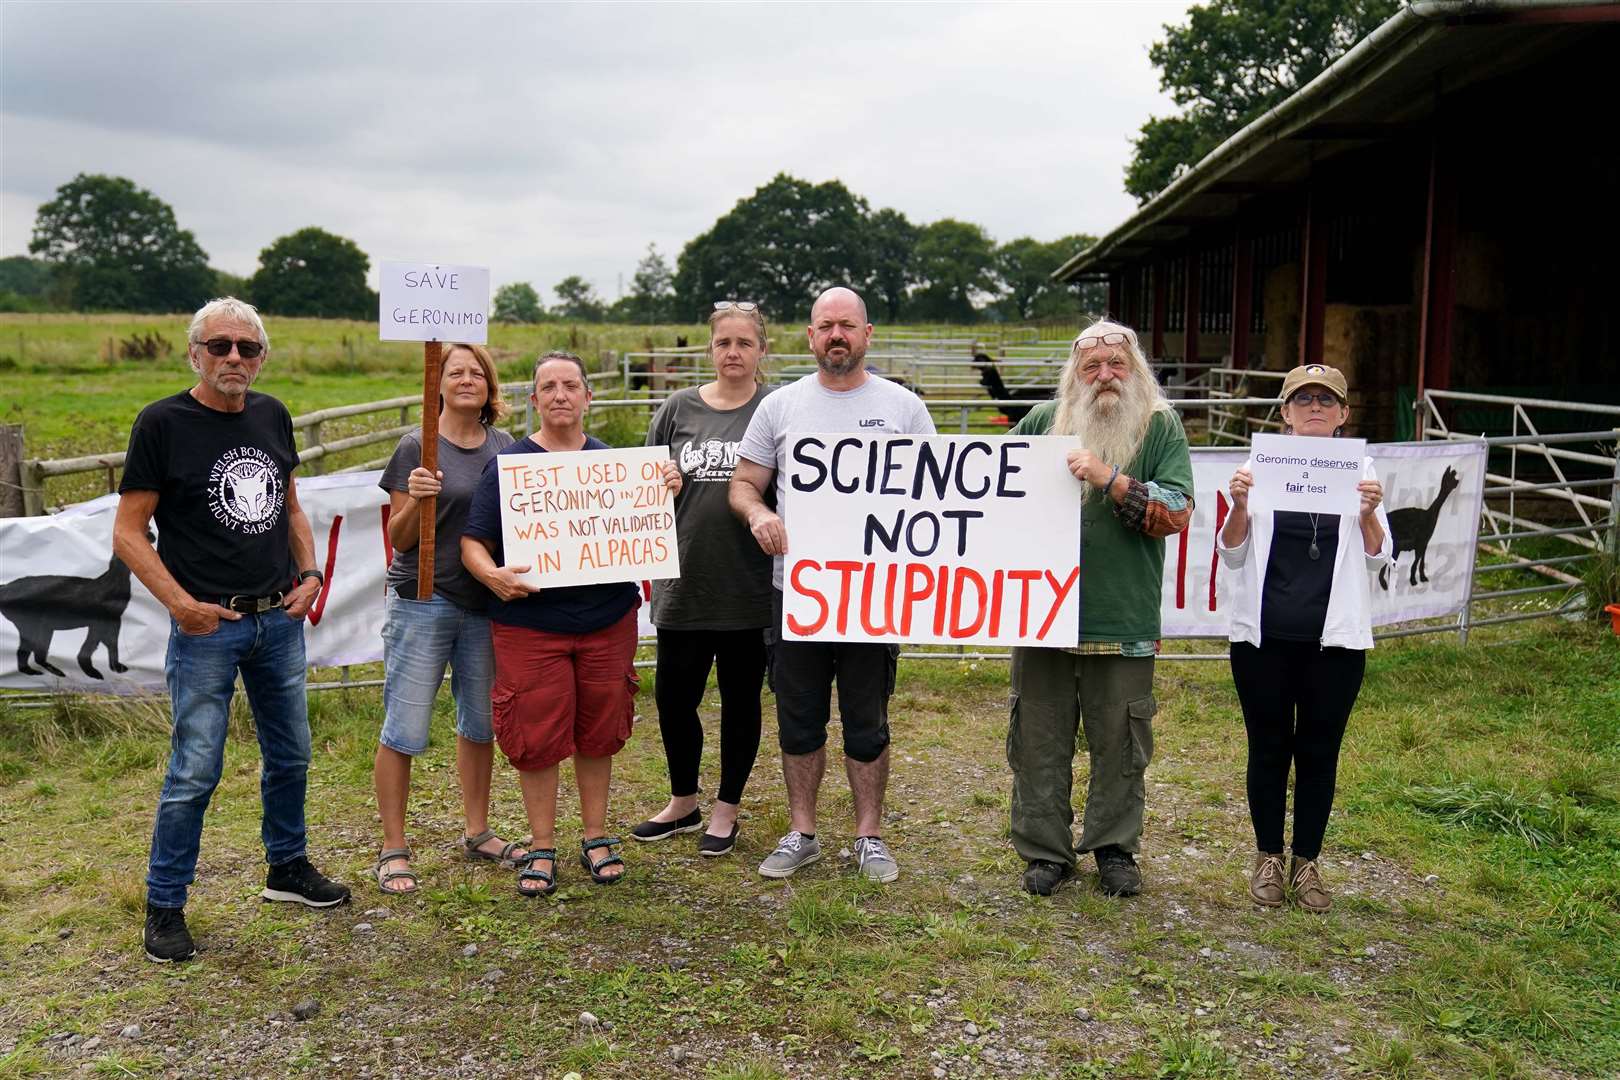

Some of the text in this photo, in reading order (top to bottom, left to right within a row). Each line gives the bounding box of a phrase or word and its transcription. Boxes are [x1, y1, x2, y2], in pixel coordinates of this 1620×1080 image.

[404, 271, 459, 290] SAVE
[393, 307, 483, 325] GERONIMO
[209, 446, 279, 482] WELSH BORDER
[503, 464, 564, 489] TEST
[577, 462, 627, 485] USED
[791, 437, 1030, 500] SCIENCE
[1256, 453, 1359, 470] Geronimo deserves
[1302, 471, 1309, 479] a
[510, 484, 671, 516] GERONIMO IN 2017
[1286, 482, 1327, 494] fair test
[209, 492, 285, 535] HUNT SABOTEURS
[514, 511, 673, 540] WAS NOT VALIDATED
[864, 509, 984, 557] NOT
[537, 536, 668, 574] IN ALPACAS
[786, 558, 1080, 640] STUPIDITY
